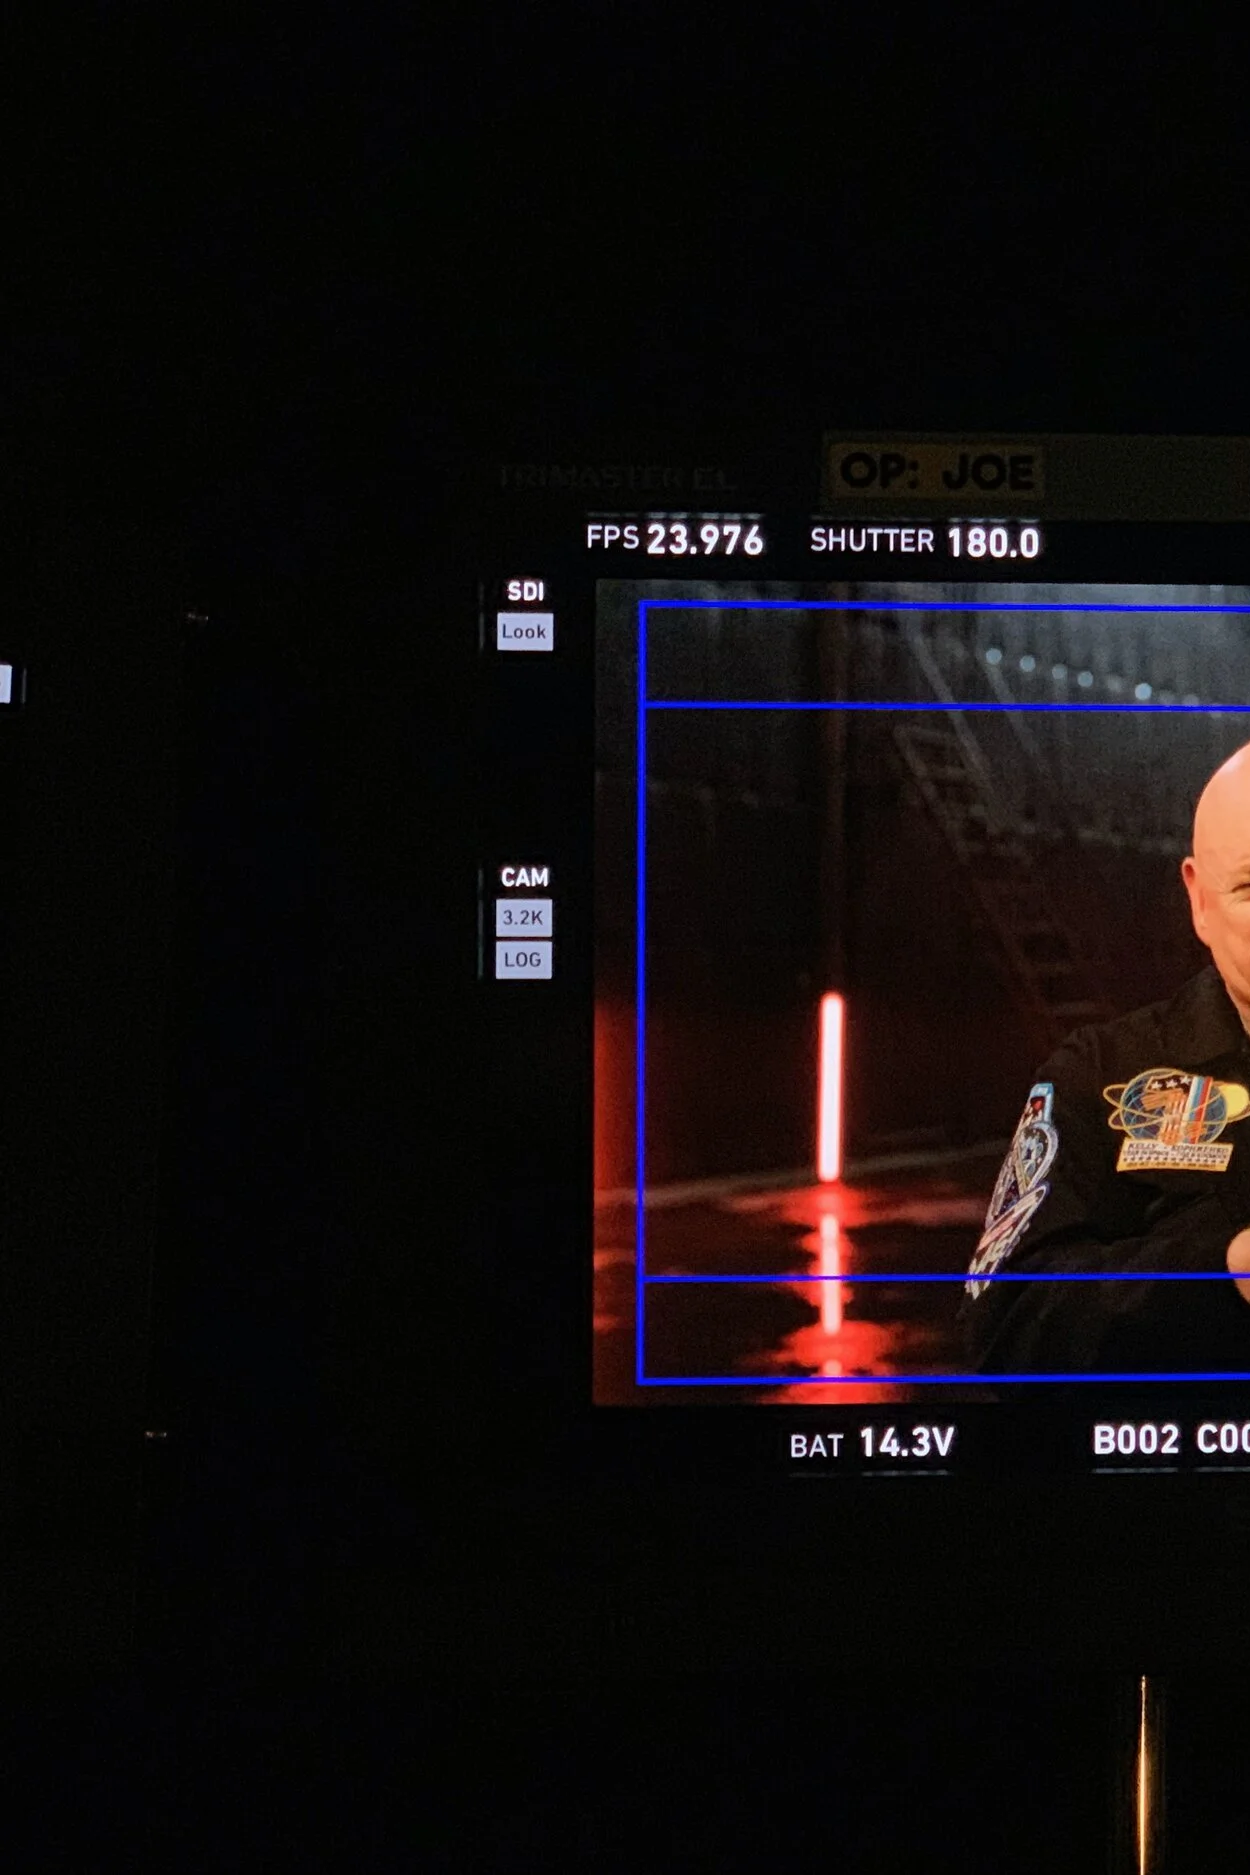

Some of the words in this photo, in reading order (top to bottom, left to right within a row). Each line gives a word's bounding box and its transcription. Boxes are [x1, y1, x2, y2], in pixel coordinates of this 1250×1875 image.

[498, 464, 683, 489] TRIMASTER
[692, 466, 738, 491] EL
[840, 452, 919, 489] OP:
[942, 453, 1035, 490] JOE
[587, 525, 640, 550] FPS
[646, 525, 764, 556] 23.976
[810, 527, 934, 553] SHUTTER
[948, 527, 1040, 559] 180.0
[506, 580, 545, 602] SDI
[502, 624, 547, 640] Look
[501, 867, 549, 888] CAM
[502, 910, 544, 926] 3.2K
[504, 952, 542, 968] LOG
[790, 1433, 844, 1458] BAT
[860, 1426, 955, 1458] 14.3V
[1093, 1423, 1180, 1455] B002
